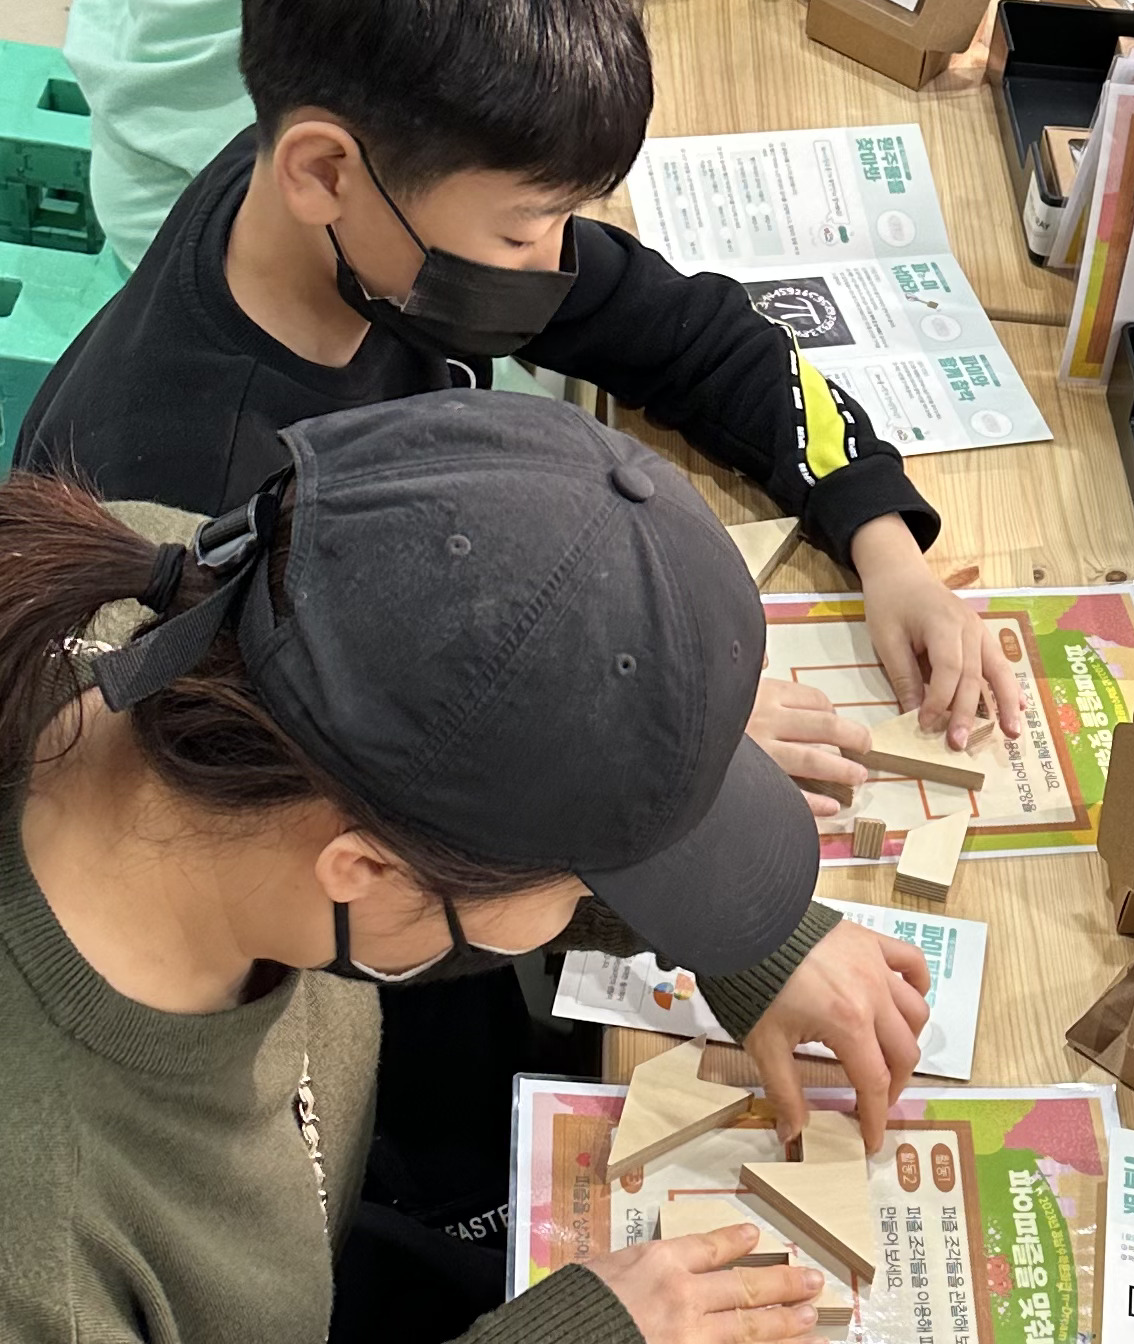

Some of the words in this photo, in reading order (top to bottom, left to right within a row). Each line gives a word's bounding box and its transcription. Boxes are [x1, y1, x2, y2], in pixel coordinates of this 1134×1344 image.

[1064, 644, 1108, 728] 파이퍼즐을
[1030, 730, 1051, 761] 관찰해
[1012, 761, 1029, 782] 파이
[1018, 783, 1037, 813] 모양을
[900, 1152, 918, 1185] 활동2
[573, 1175, 591, 1213] 퍼즐을
[880, 1206, 899, 1246] 만들어
[906, 1206, 923, 1233] 퍼즐
[941, 1206, 958, 1233] 퍼즐
[1009, 1169, 1048, 1289] 파이퍼즐을
[909, 1236, 928, 1289] 조각들을
[944, 1235, 964, 1288] 조각들을
[914, 1291, 932, 1333] 이용해
[949, 1290, 969, 1333] 관찰해
